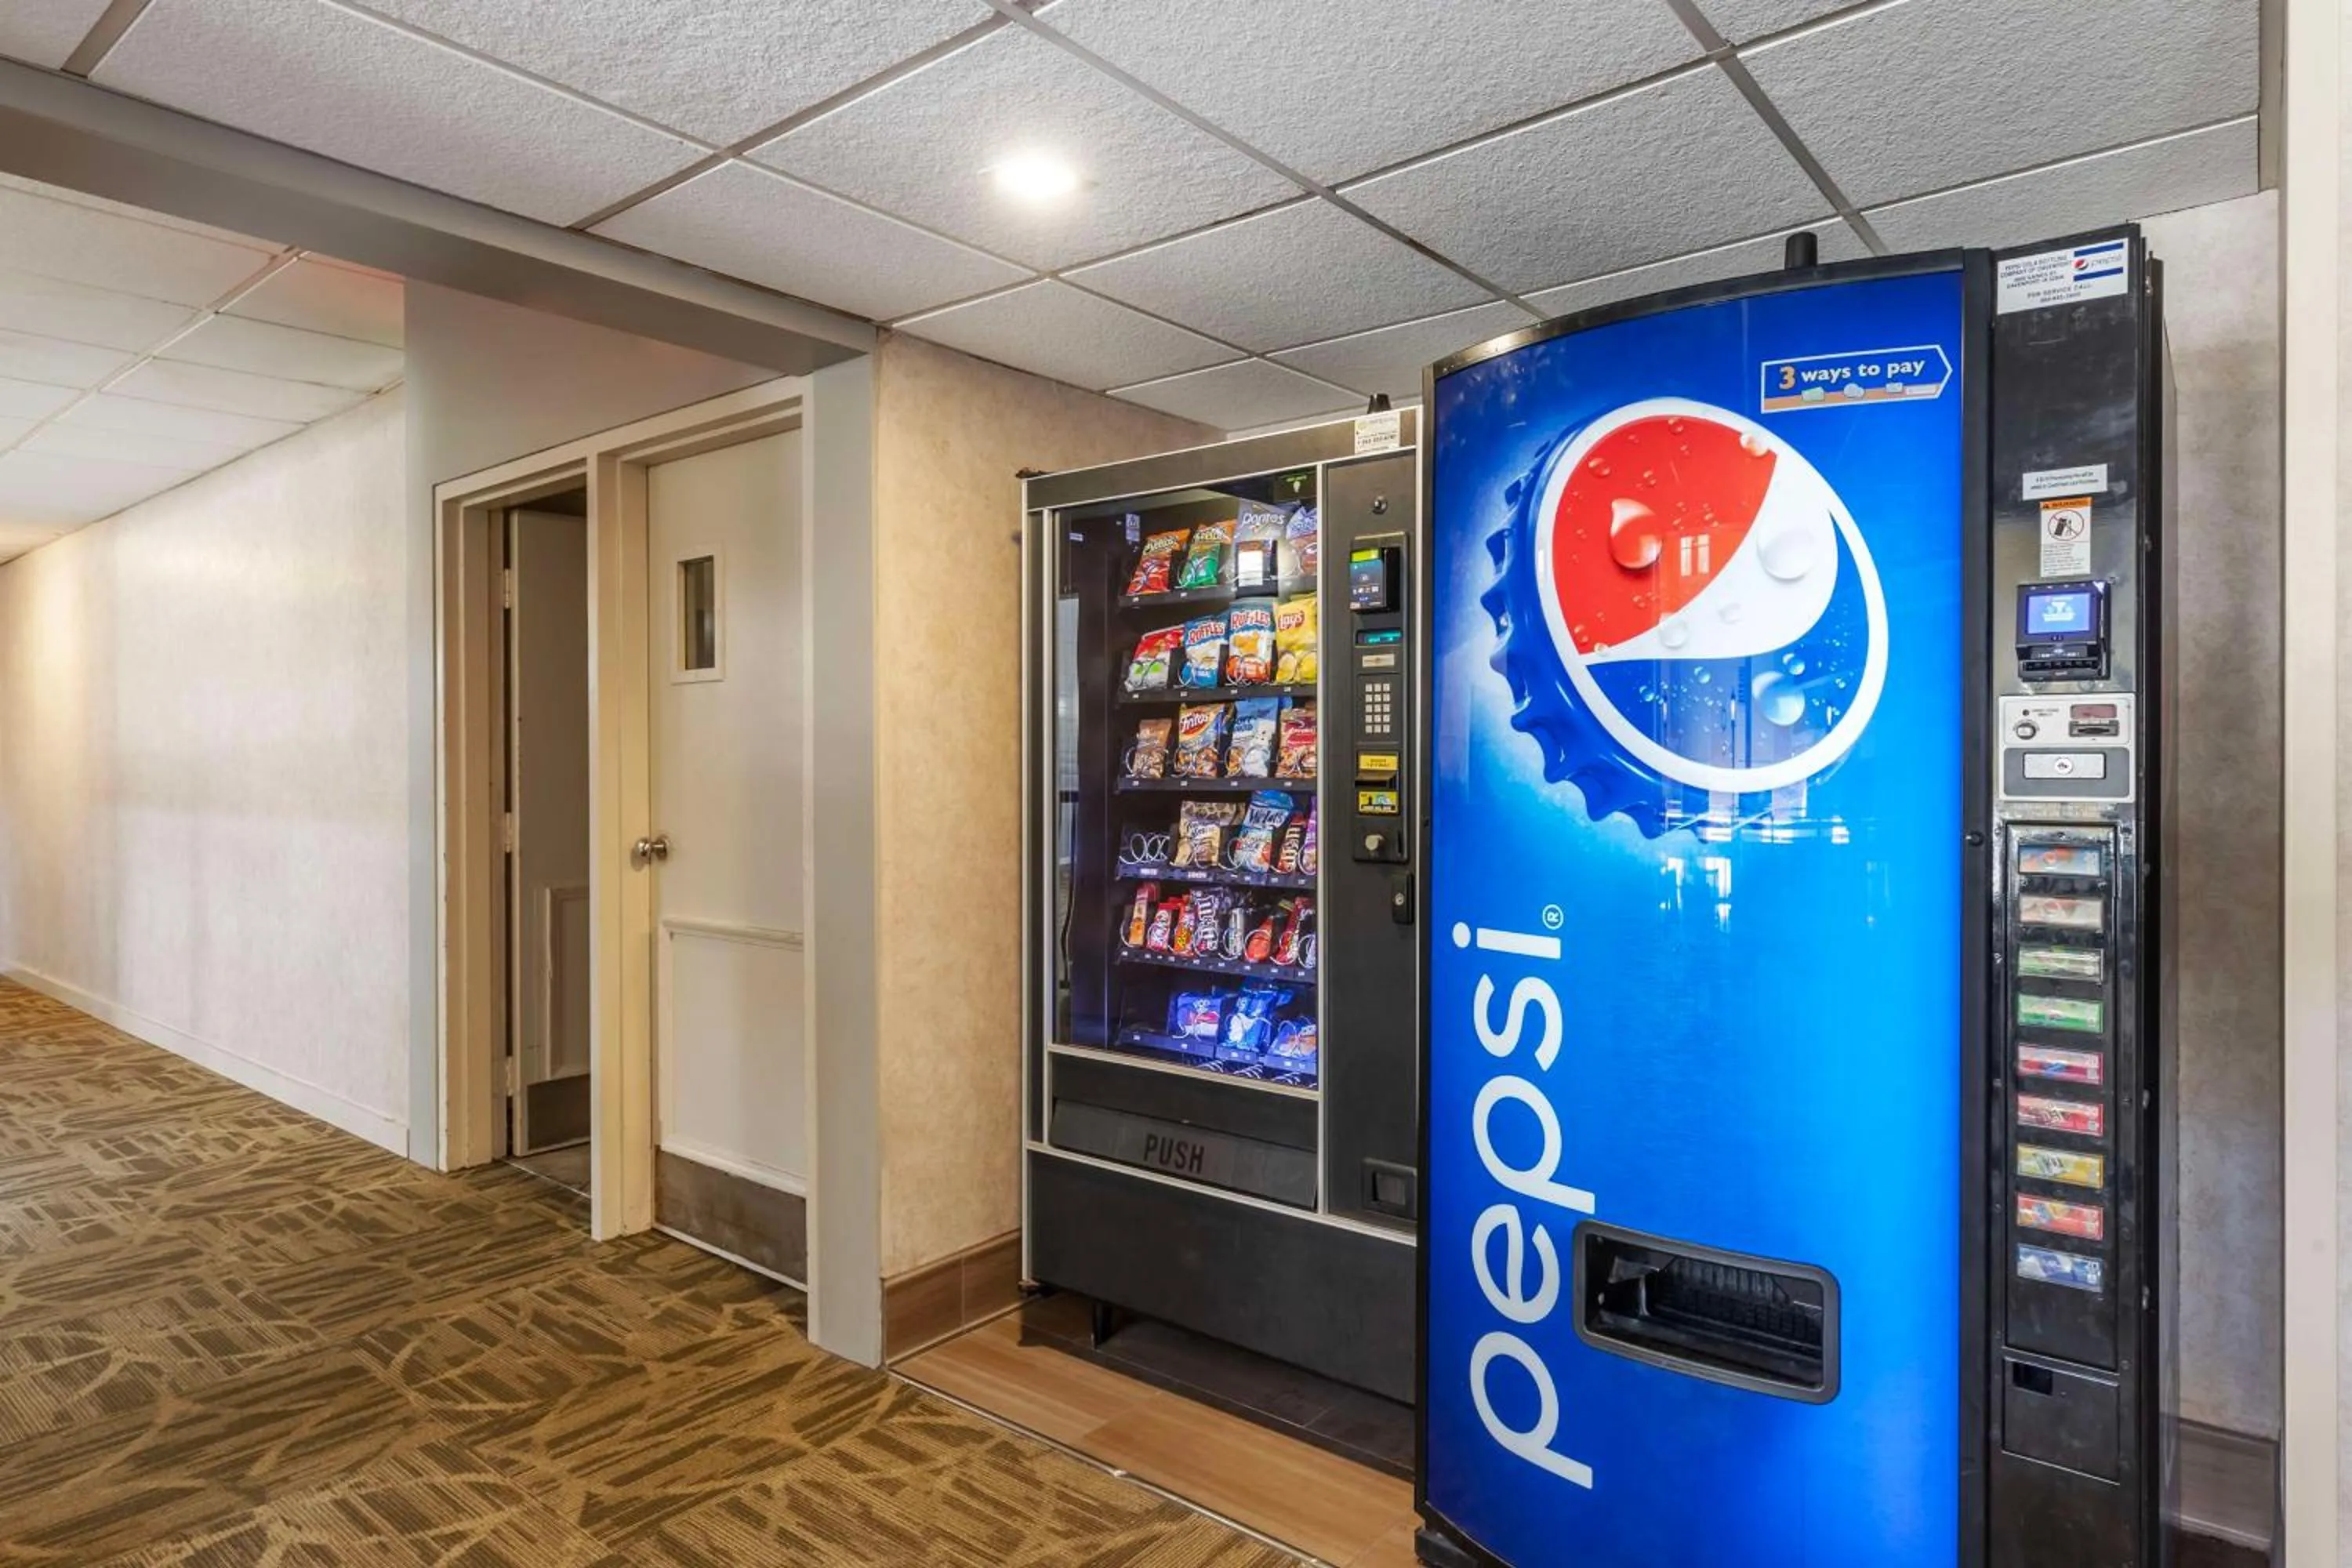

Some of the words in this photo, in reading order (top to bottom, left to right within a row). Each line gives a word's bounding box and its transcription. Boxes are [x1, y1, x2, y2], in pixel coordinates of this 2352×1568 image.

[1779, 366, 1795, 390] 3
[1801, 366, 1851, 383] ways
[1858, 363, 1881, 376] to
[1887, 360, 1926, 378] pay
[1241, 513, 1287, 527] Doritos
[1231, 609, 1271, 630] RUFFLES
[1188, 621, 1225, 644] RUFFLES
[1180, 713, 1208, 734] Fritos
[1144, 1134, 1205, 1174] PUSH
[1452, 922, 1595, 1489] pepsi
